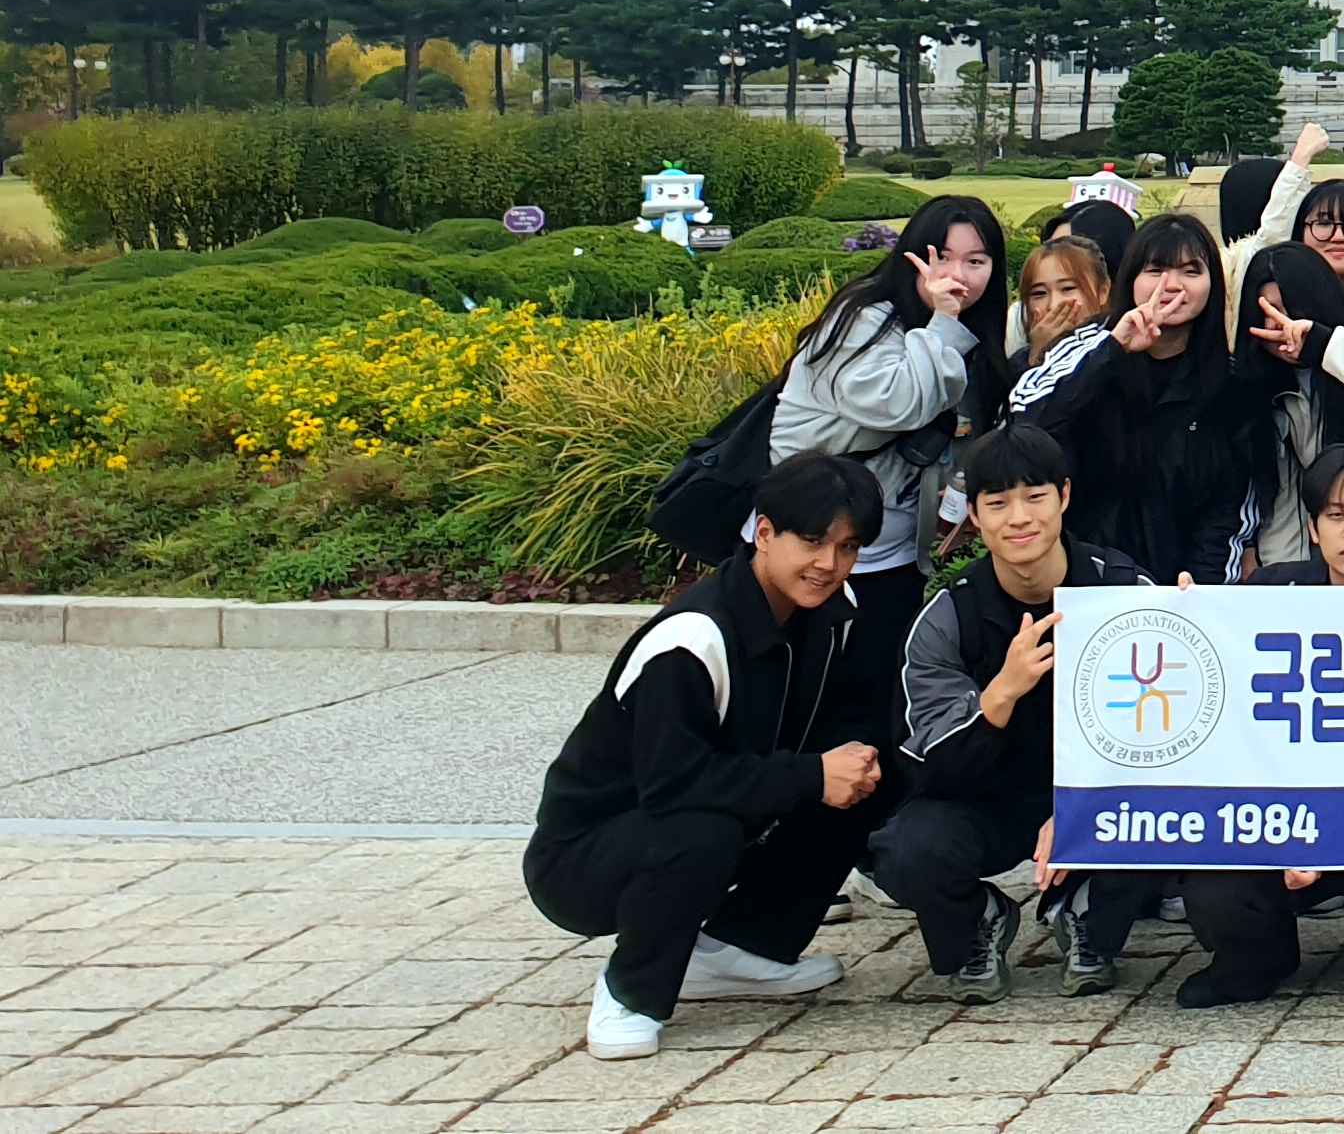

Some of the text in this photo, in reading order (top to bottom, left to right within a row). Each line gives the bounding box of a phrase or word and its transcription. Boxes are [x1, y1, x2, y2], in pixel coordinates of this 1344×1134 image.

[1142, 616, 1201, 650] NATIONAL
[1198, 648, 1219, 728] UNIVERSITY
[1096, 802, 1318, 844] since 1984
